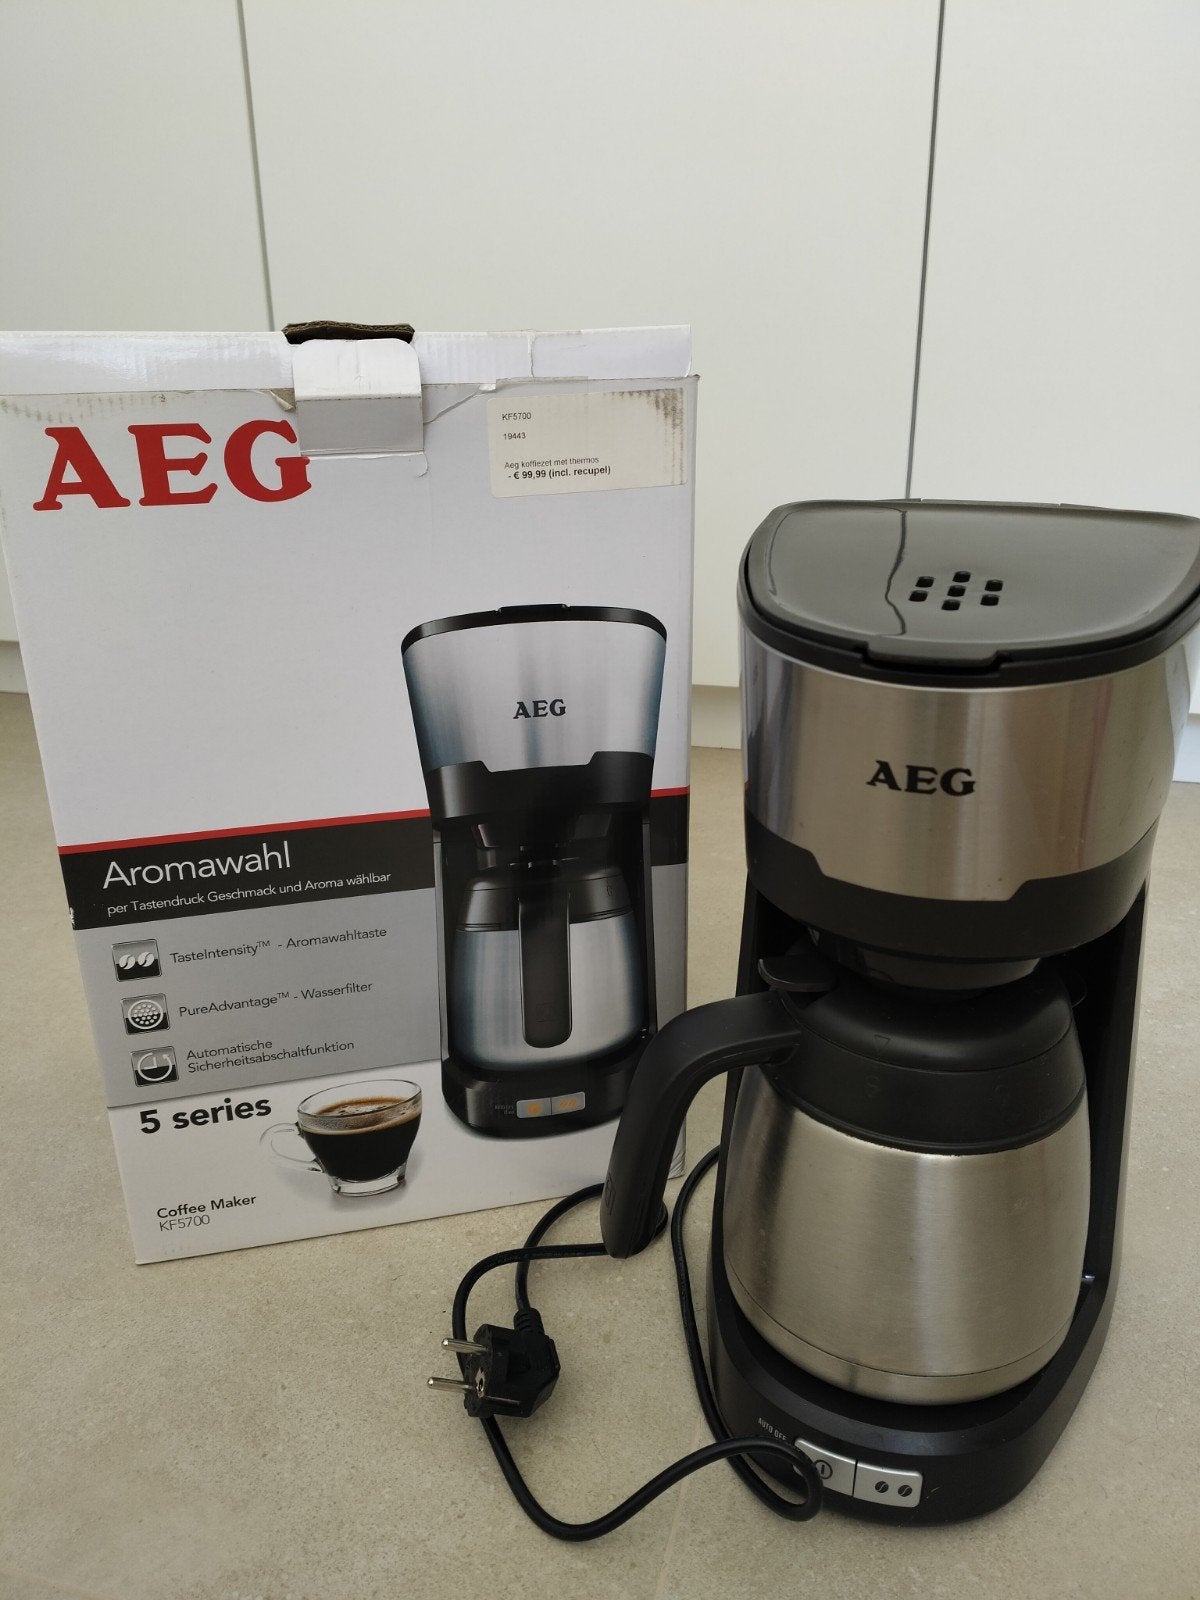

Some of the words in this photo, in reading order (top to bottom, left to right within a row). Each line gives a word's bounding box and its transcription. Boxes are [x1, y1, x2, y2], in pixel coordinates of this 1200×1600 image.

[502, 412, 532, 421] KF5700
[503, 432, 526, 440] 19443
[33, 419, 312, 511] AEG
[504, 461, 519, 470] Aeg
[521, 459, 552, 468] koffiezet
[553, 458, 568, 466] met
[569, 456, 599, 465] thermos
[513, 471, 520, 479] €
[522, 469, 546, 480] 99,99
[549, 468, 571, 479] (incl.
[573, 465, 611, 477] recupel)
[513, 699, 566, 719] AEG
[866, 760, 976, 796] AEG
[103, 840, 291, 889] Aromawahl
[107, 902, 128, 917] per
[130, 892, 205, 912] Tastendruck
[207, 884, 277, 902] Geschmack
[279, 880, 302, 894] und
[304, 877, 344, 891] Aroma
[346, 871, 392, 886] wählbar
[286, 928, 387, 949] Aromawahltaste
[301, 982, 373, 1000] Wasserfilter
[186, 1040, 273, 1061] Automatische
[188, 1040, 355, 1073] Sicherheitsabschaltfunktion
[140, 1108, 161, 1134] 5
[172, 1097, 272, 1130] series
[157, 1203, 206, 1219] Coffee
[210, 1195, 257, 1211] Maker
[159, 1214, 210, 1232] KF5700
[757, 1417, 774, 1434] AUTO
[774, 1429, 788, 1441] OFF
